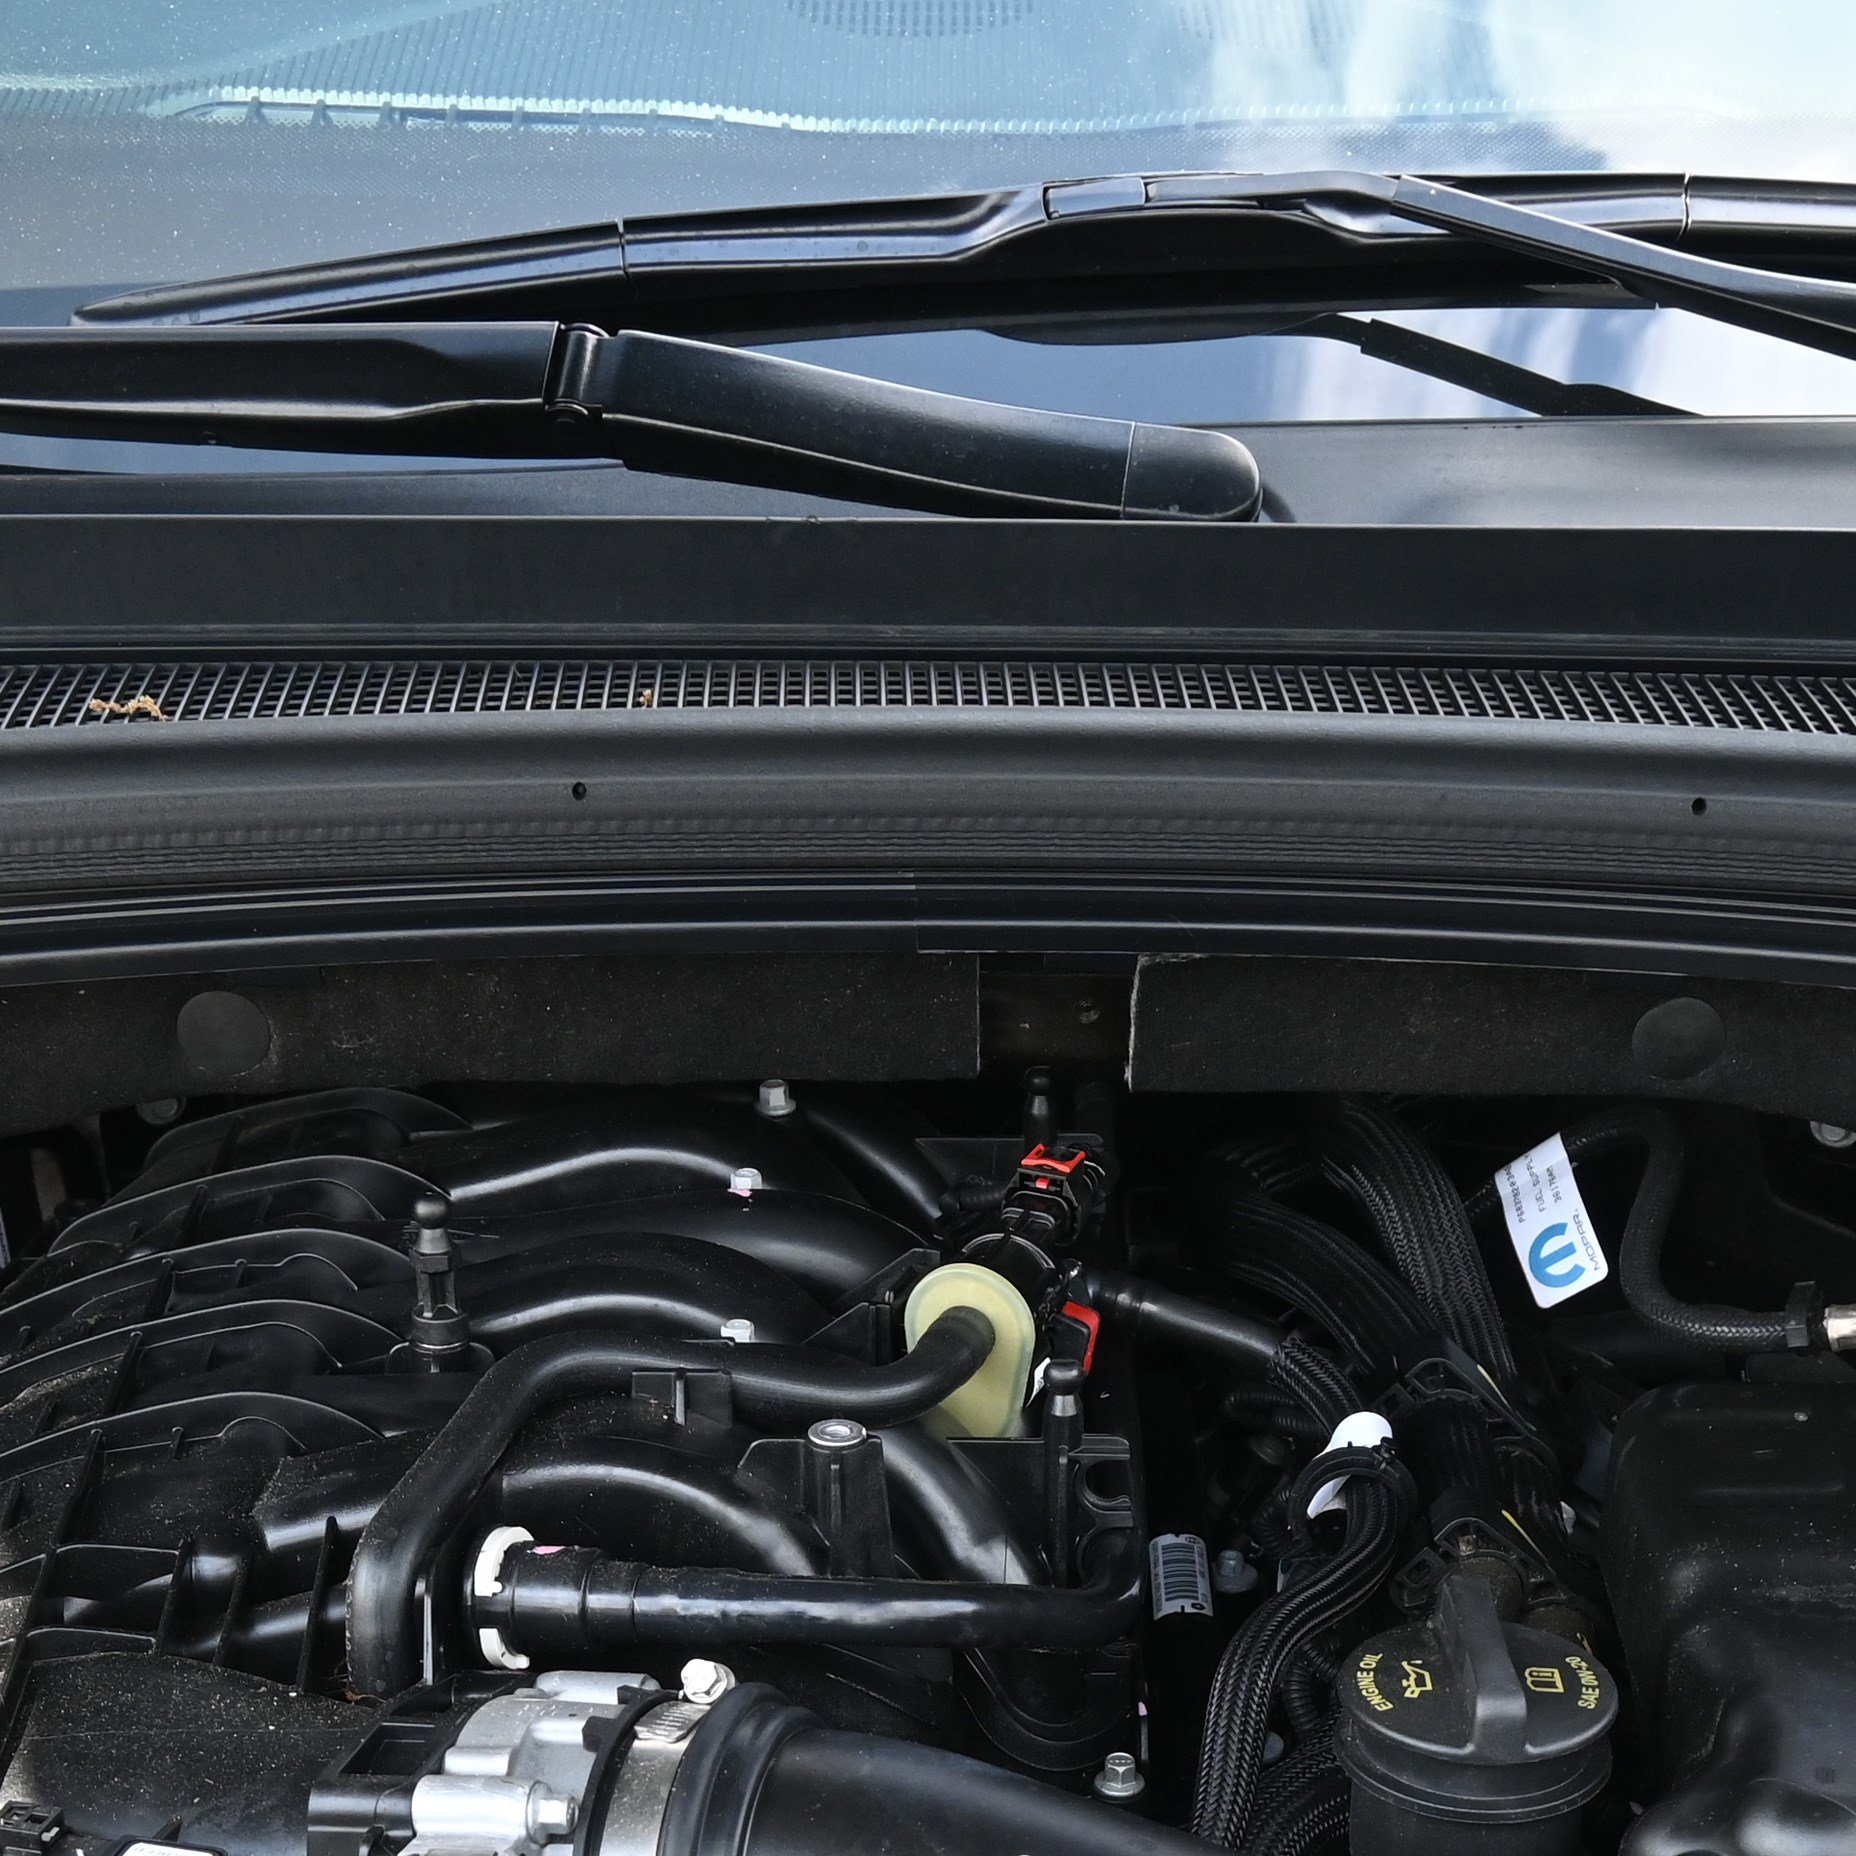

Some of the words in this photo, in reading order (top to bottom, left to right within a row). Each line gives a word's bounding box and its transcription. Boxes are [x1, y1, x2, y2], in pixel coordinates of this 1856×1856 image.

[1534, 1189, 1547, 1213] FUEL
[1361, 1652, 1383, 1669] OIL
[1565, 1656, 1599, 1687] 0W-20
[1356, 1670, 1394, 1712] ENGINE
[1578, 1687, 1600, 1709] SAE
